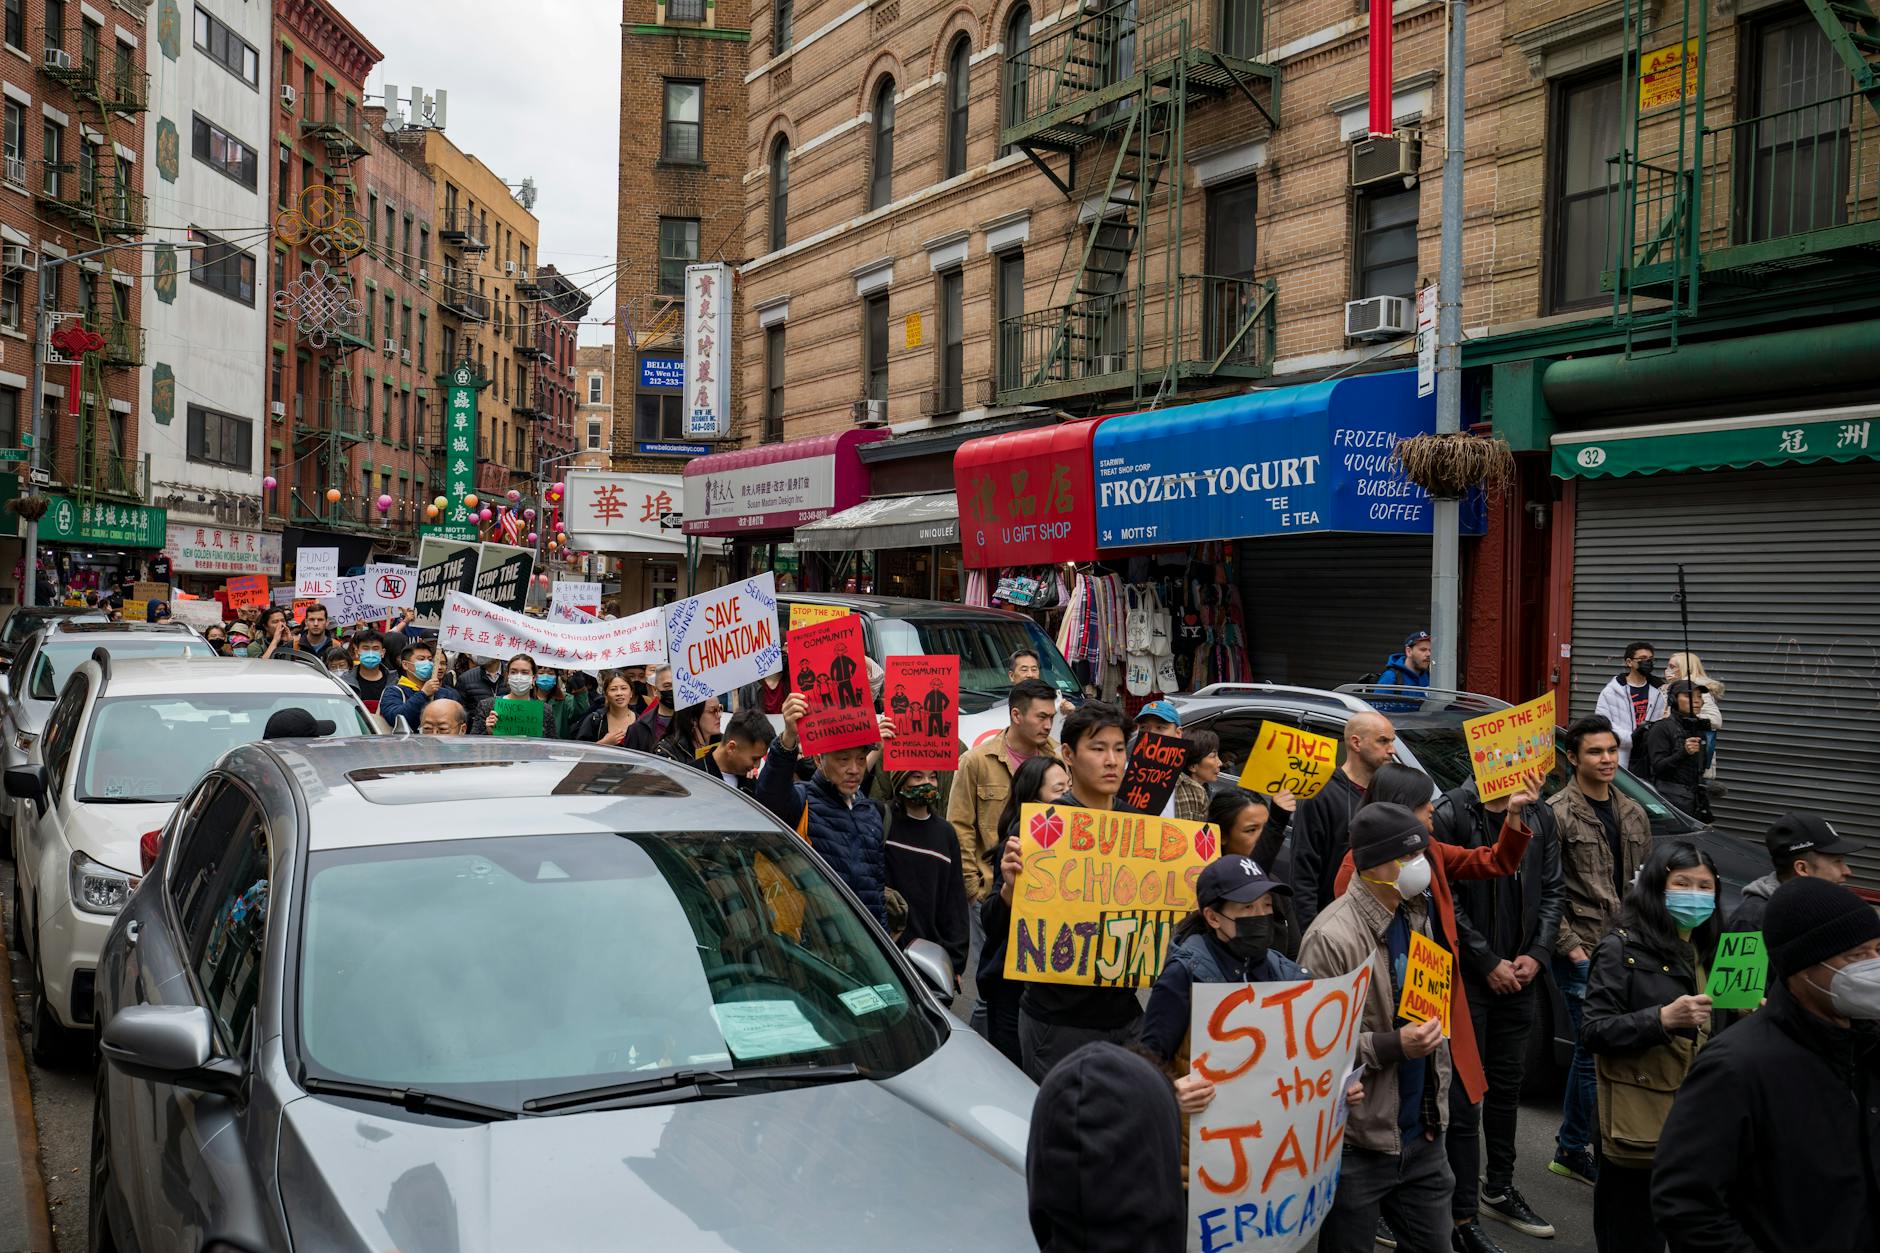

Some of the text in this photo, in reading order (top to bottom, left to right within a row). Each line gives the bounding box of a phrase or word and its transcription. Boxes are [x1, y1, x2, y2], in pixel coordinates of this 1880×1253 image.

[646, 361, 671, 370] BELLA
[1334, 429, 1397, 449] FROZEN
[1584, 449, 1599, 465] 32
[1100, 463, 1151, 477] TREAT SHOP CORP
[1100, 455, 1320, 508] FROZEN YOGURT
[1357, 478, 1413, 498] BUBBLE
[779, 496, 794, 506] Design
[1370, 503, 1422, 520] COFFEE
[1293, 511, 1320, 525] TEA
[919, 526, 954, 539] UNIQULEE
[1013, 525, 1037, 543] GIFT
[1039, 522, 1072, 541] SHOP
[1102, 525, 1158, 542] 34 MOTT ST
[183, 548, 193, 558] NEW
[194, 548, 211, 559] GOLDEN
[212, 549, 223, 560] FUNG
[236, 552, 252, 562] BAKERY
[300, 551, 332, 562] FUND
[419, 557, 466, 586] STOP THE
[478, 562, 520, 589] STOP THE
[416, 585, 439, 602] MEGA
[496, 583, 516, 601] JAIL
[744, 580, 776, 611] SENIORS
[452, 603, 482, 616] Mayor
[544, 629, 558, 638] the
[560, 632, 611, 641] Chinatown
[613, 626, 638, 637] Mega
[668, 600, 687, 634] SMALL
[704, 596, 742, 634] SAVE
[793, 607, 847, 617] STOP THE JAIL
[671, 599, 699, 653] BUSINESS
[688, 617, 772, 676] CHINATOWN
[803, 628, 855, 649] COMMUNITY
[676, 667, 715, 698] COLUMBUS
[901, 667, 952, 676] COMMUNITY
[678, 685, 700, 704] PARK
[817, 717, 837, 726] MEGA
[839, 713, 854, 722] JAIL
[1471, 700, 1553, 740] STOP THE JAIL
[806, 721, 871, 742] CHINATOWN
[890, 749, 951, 759] CHINATOWN
[1133, 732, 1185, 768] Adams
[1266, 729, 1332, 762] JAIL!
[1483, 772, 1521, 794] INVEST
[1127, 786, 1150, 809] the
[1069, 812, 1188, 862] BUILD
[1016, 917, 1100, 977] NOT
[1721, 936, 1759, 957] NO
[1413, 941, 1445, 977] ADAMS
[1413, 968, 1424, 987] IS
[1428, 978, 1445, 999] NOT
[1713, 967, 1764, 997] JAIL
[1405, 990, 1442, 1020] ADDING
[1192, 965, 1372, 1084] STOP
[1271, 1066, 1333, 1111] the
[1197, 1098, 1345, 1195] JAIL
